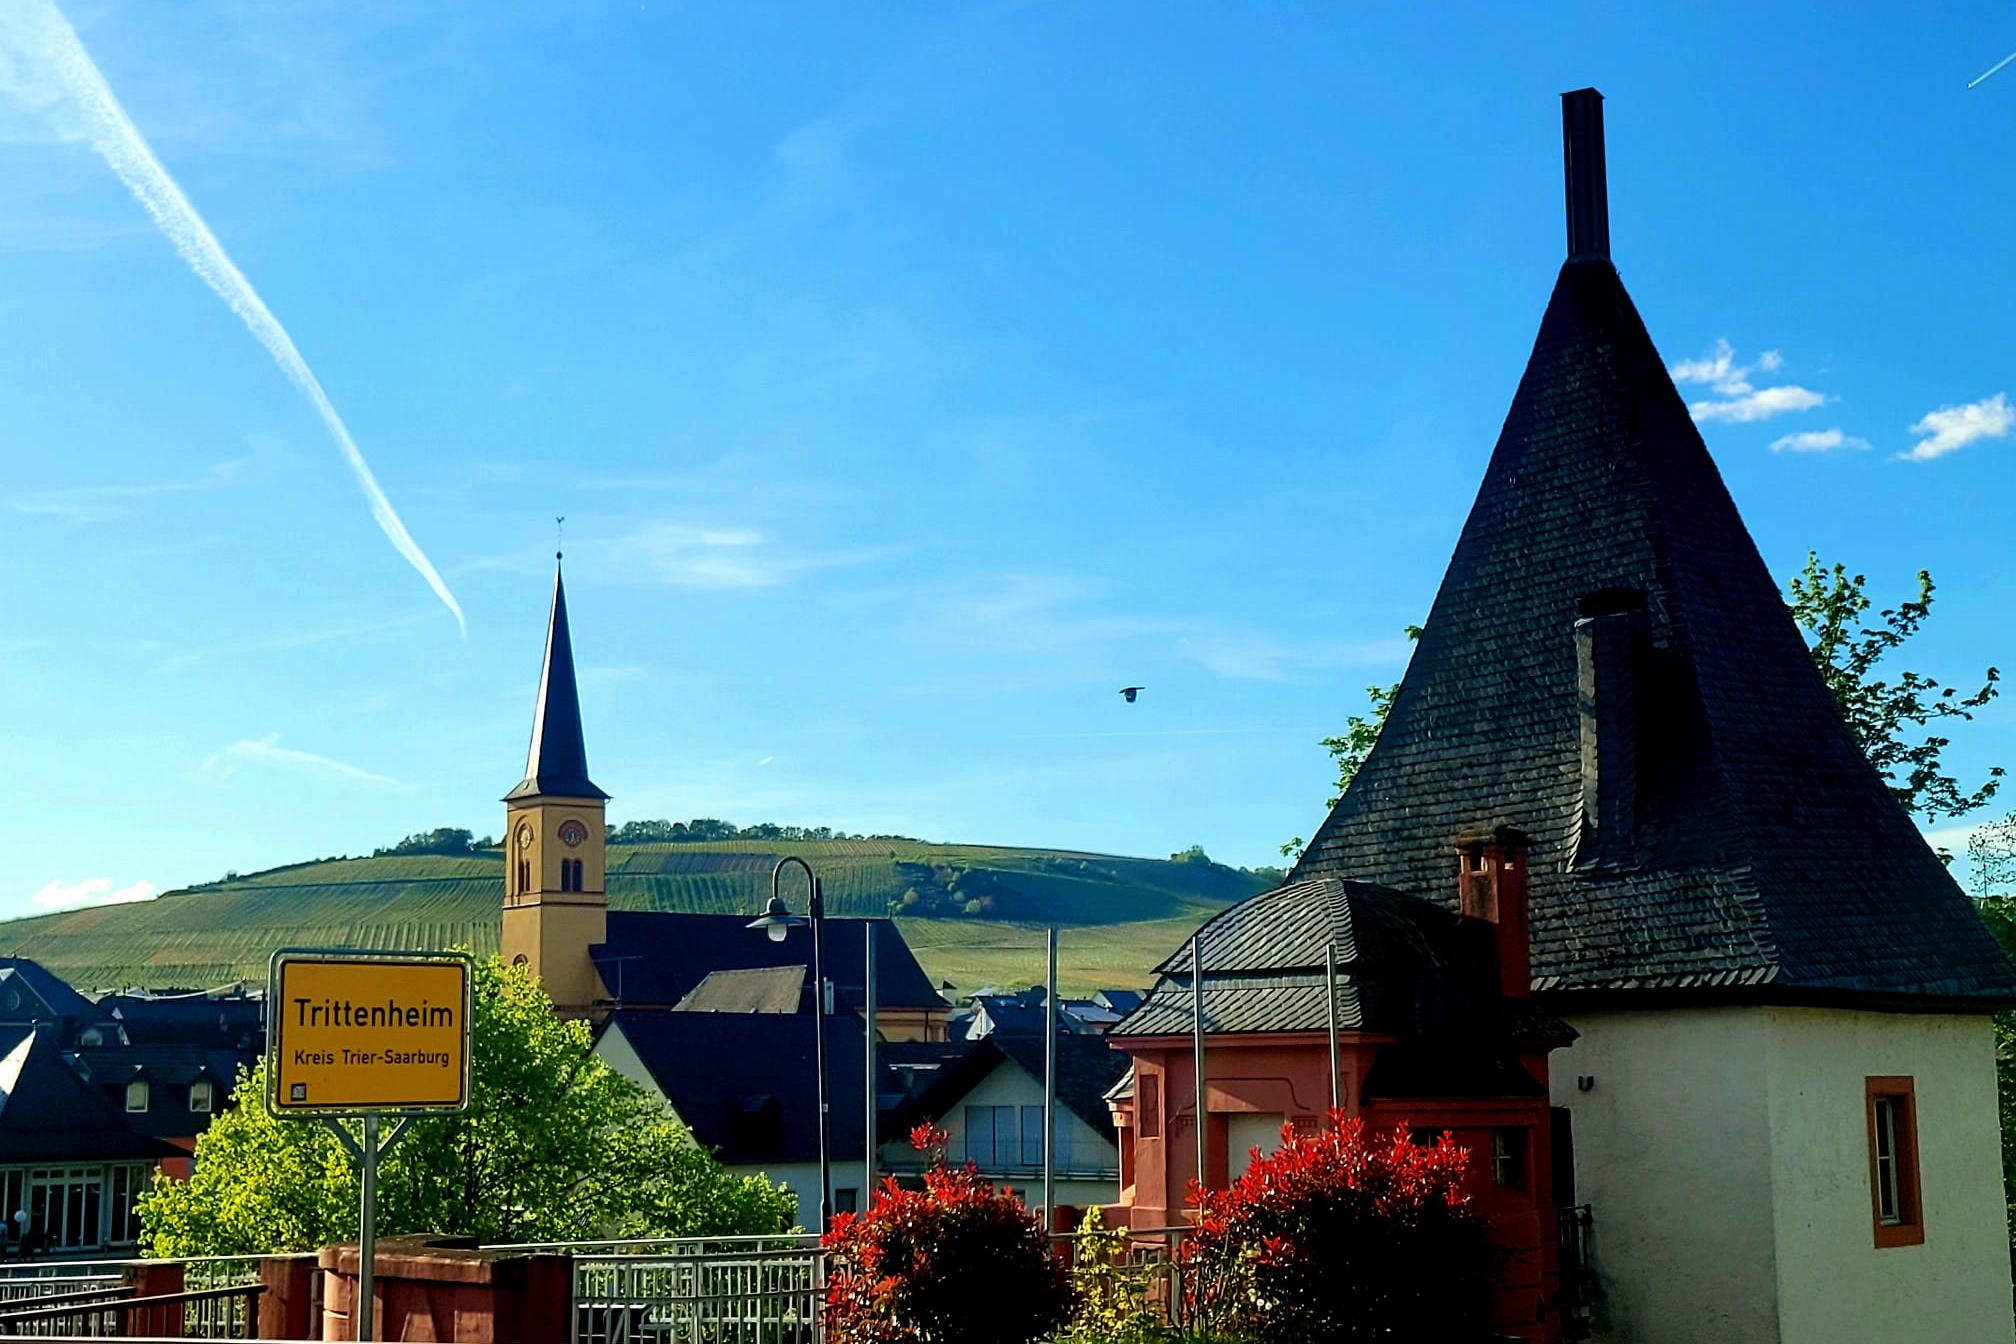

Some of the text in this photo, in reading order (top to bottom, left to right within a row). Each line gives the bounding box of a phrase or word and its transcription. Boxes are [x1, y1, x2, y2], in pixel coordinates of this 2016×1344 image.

[293, 998, 453, 1027] Trittenheim
[294, 1049, 450, 1068] Kreis Trier-Saarburg
